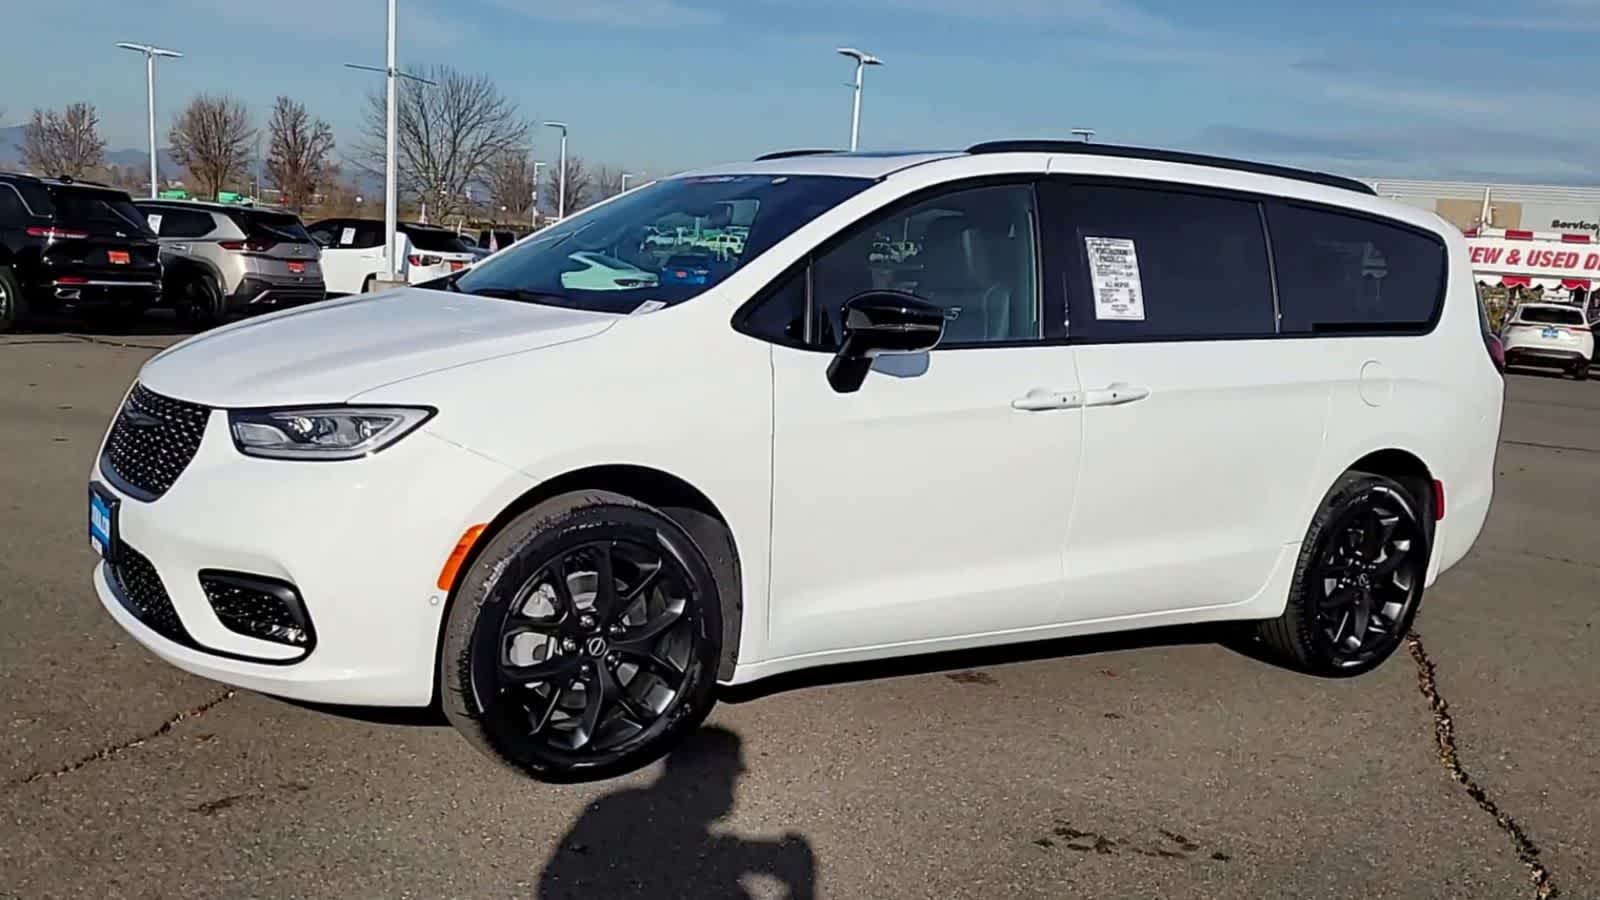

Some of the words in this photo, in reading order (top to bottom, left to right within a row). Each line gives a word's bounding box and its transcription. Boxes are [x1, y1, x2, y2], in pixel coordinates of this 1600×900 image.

[1551, 219, 1599, 231] Service
[1506, 249, 1521, 266] &
[1527, 250, 1579, 269] USED
[1584, 253, 1600, 271] D
